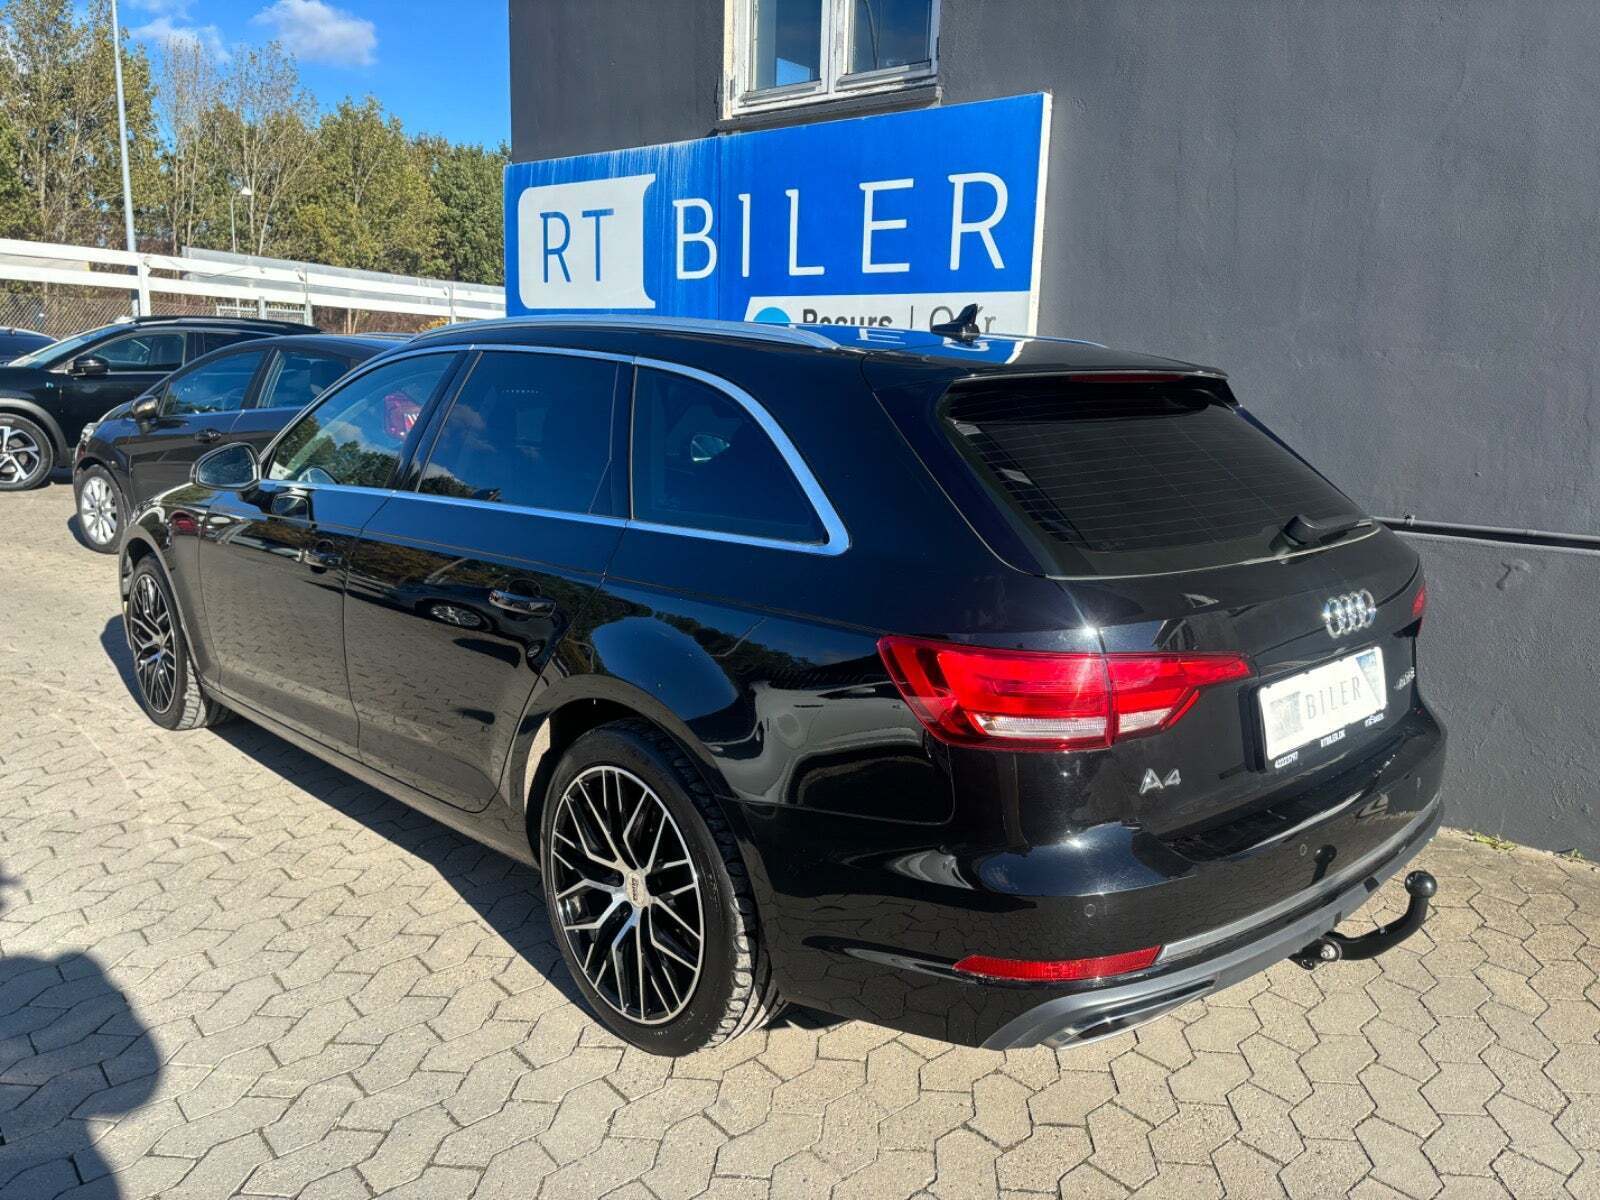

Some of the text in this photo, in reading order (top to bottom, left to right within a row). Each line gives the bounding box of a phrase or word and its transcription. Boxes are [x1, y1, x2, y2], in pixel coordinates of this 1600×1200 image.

[540, 171, 1009, 283] RT BILER
[1304, 676, 1362, 720] BILER
[1139, 768, 1181, 794] A4
